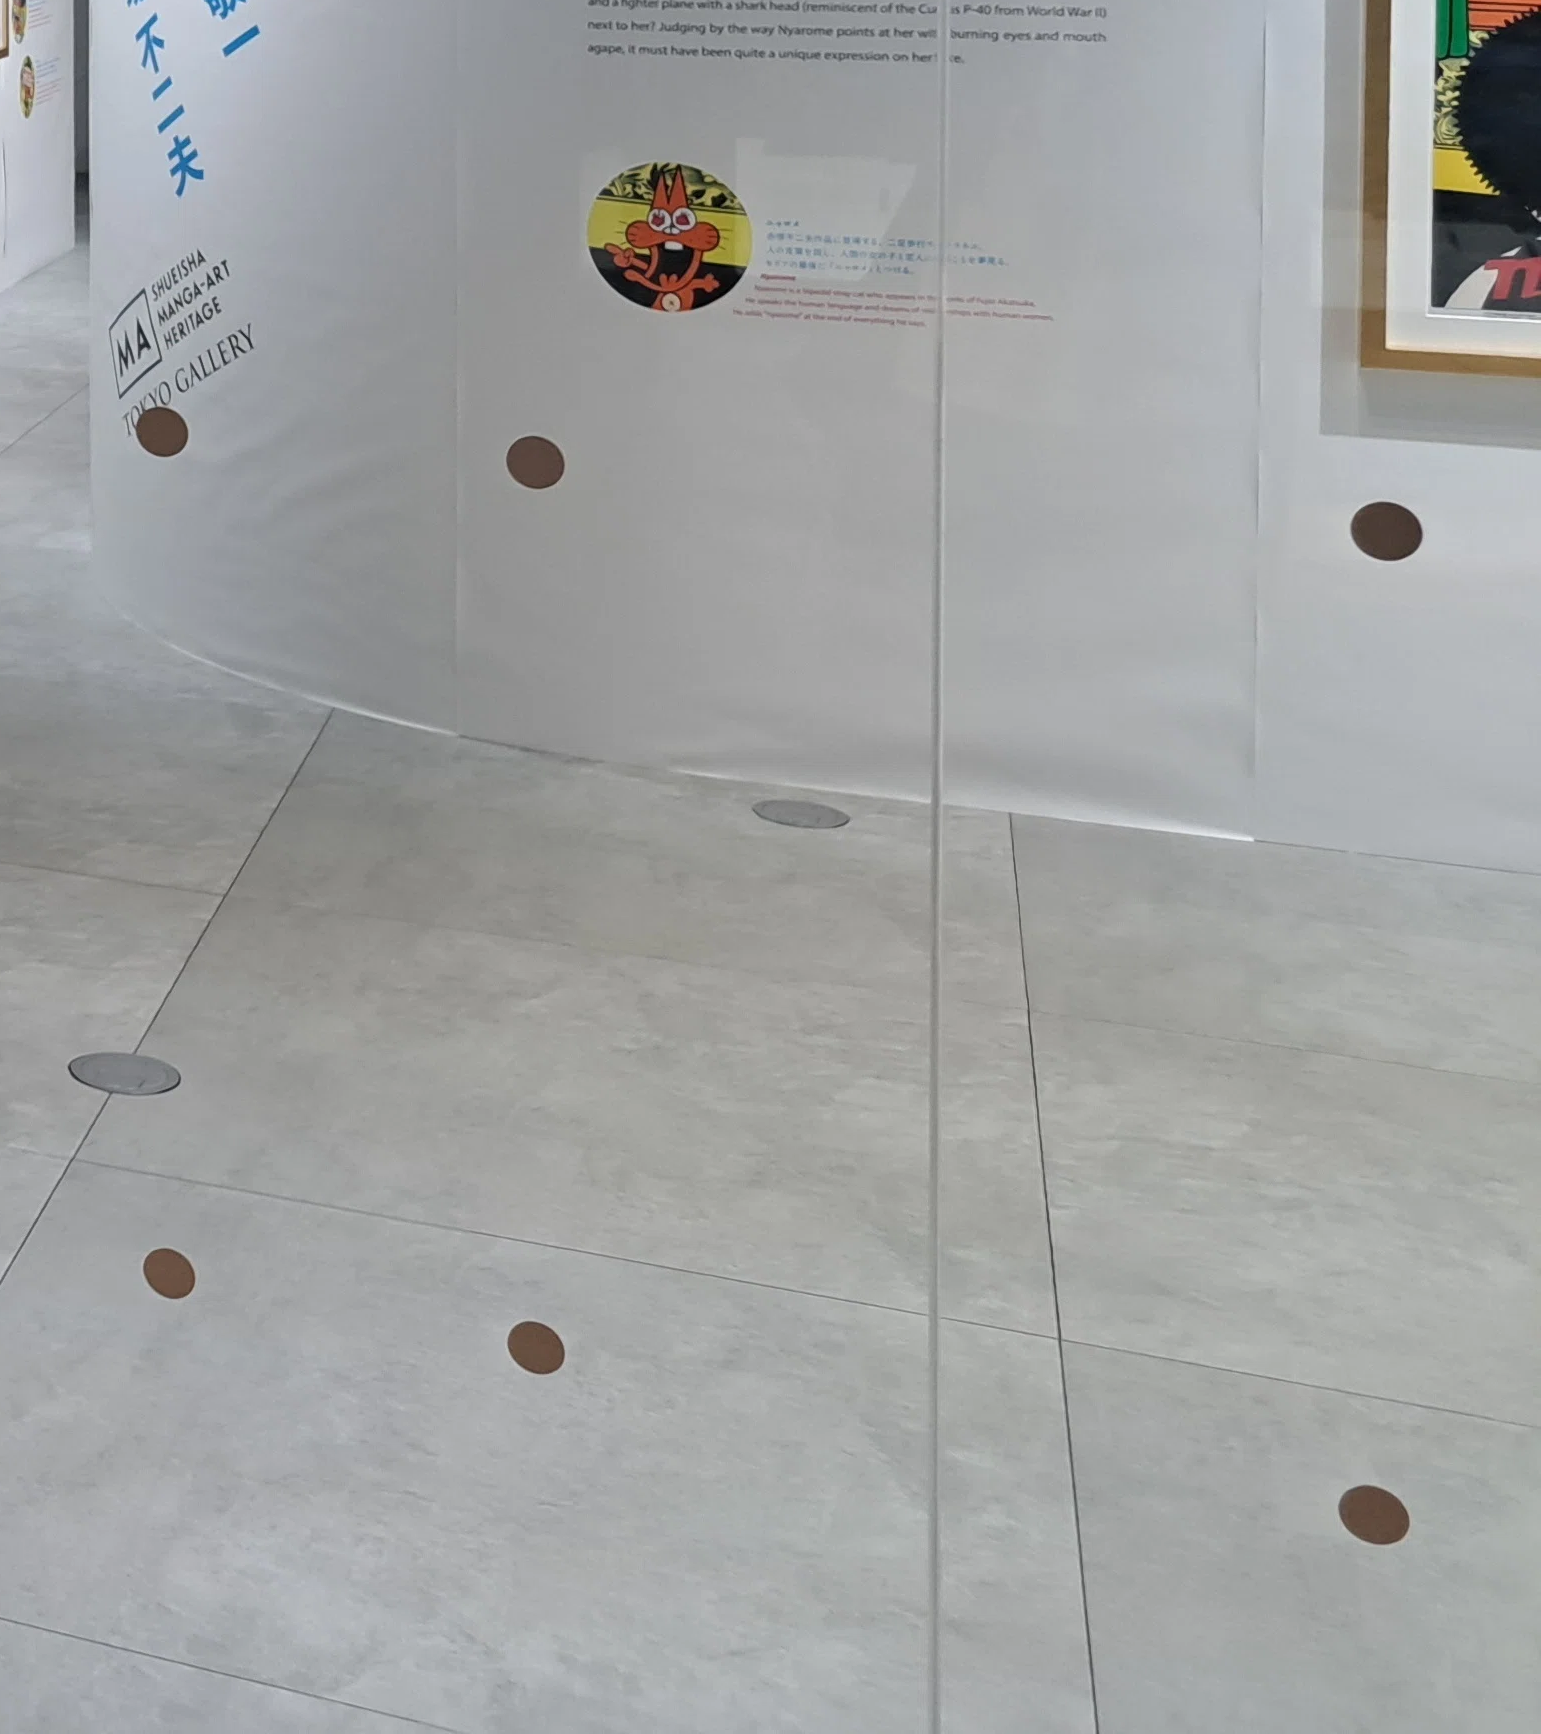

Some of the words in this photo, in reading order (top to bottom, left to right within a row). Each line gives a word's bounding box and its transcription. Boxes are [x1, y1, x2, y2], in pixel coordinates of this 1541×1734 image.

[151, 248, 207, 302] SHUEISHA
[157, 259, 231, 326] MANGA-ART
[117, 317, 151, 377] MA
[163, 296, 223, 350] HERITAGE
[175, 323, 255, 394] GALLERY
